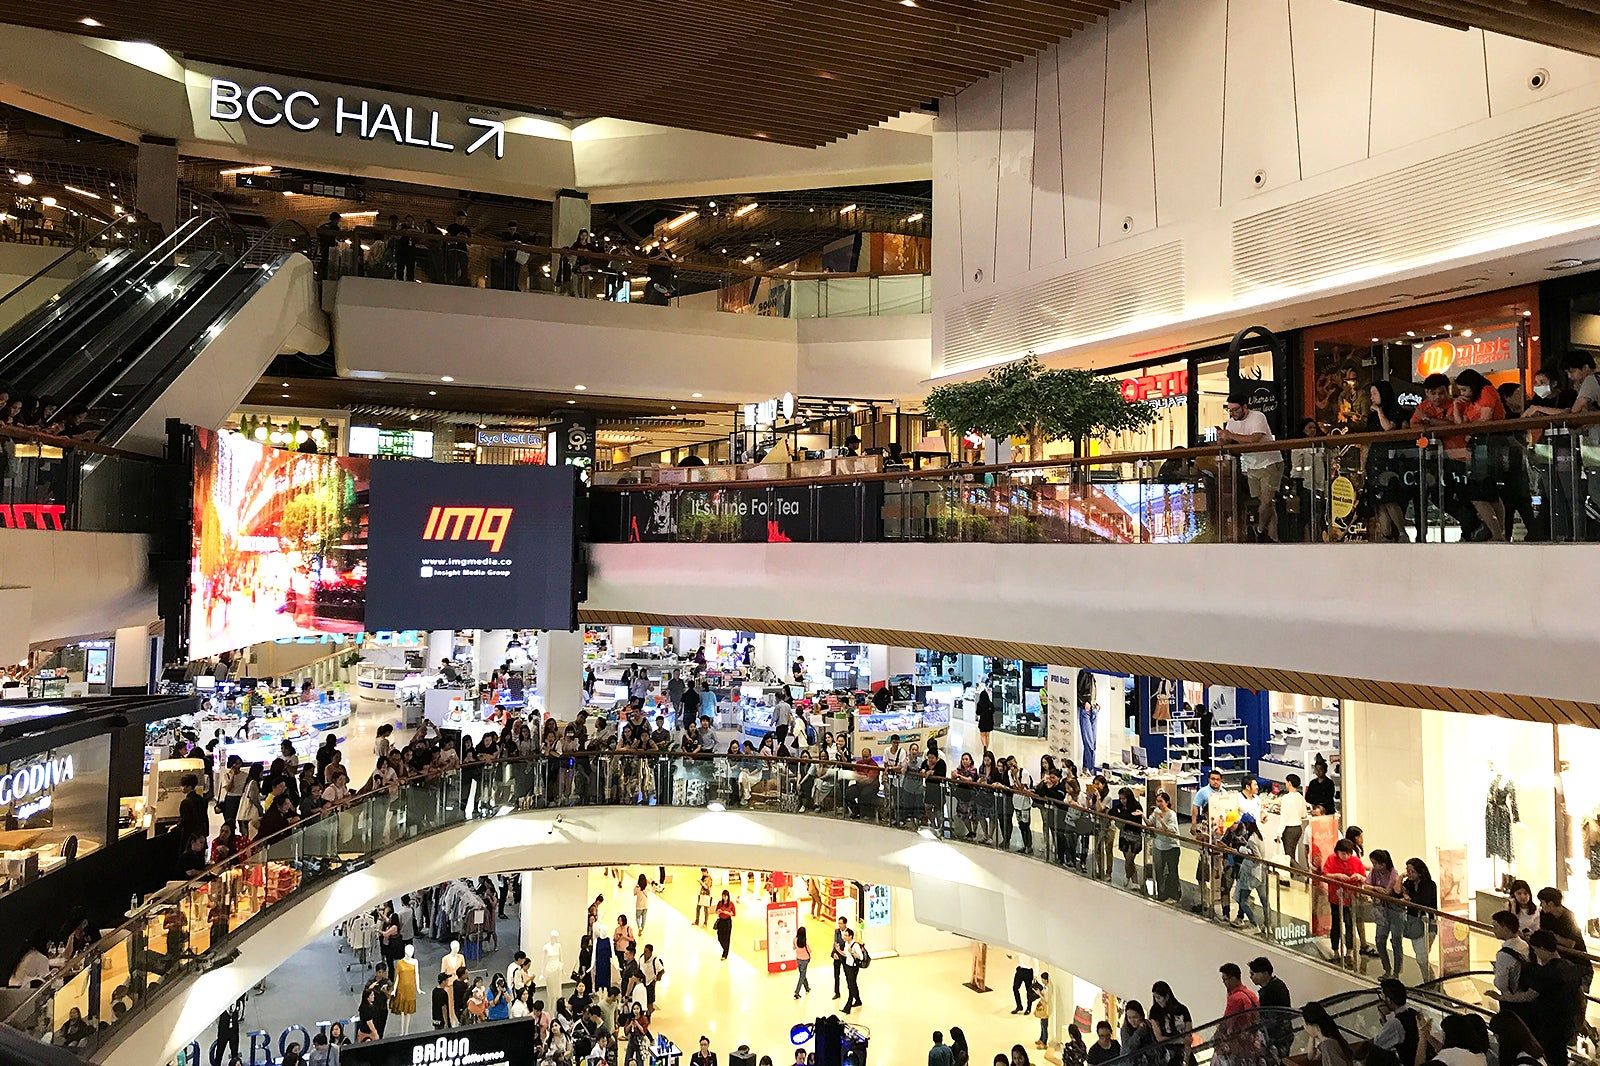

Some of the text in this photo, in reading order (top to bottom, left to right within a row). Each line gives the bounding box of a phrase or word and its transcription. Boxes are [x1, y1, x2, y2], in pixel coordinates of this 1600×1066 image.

[210, 78, 454, 151] BCC HALL
[478, 431, 500, 446] Kyo
[777, 498, 799, 515] Tea
[421, 557, 512, 567] www.imgmedia.co
[0, 754, 74, 805] GODIVA
[412, 1036, 470, 1063] BRAUN
